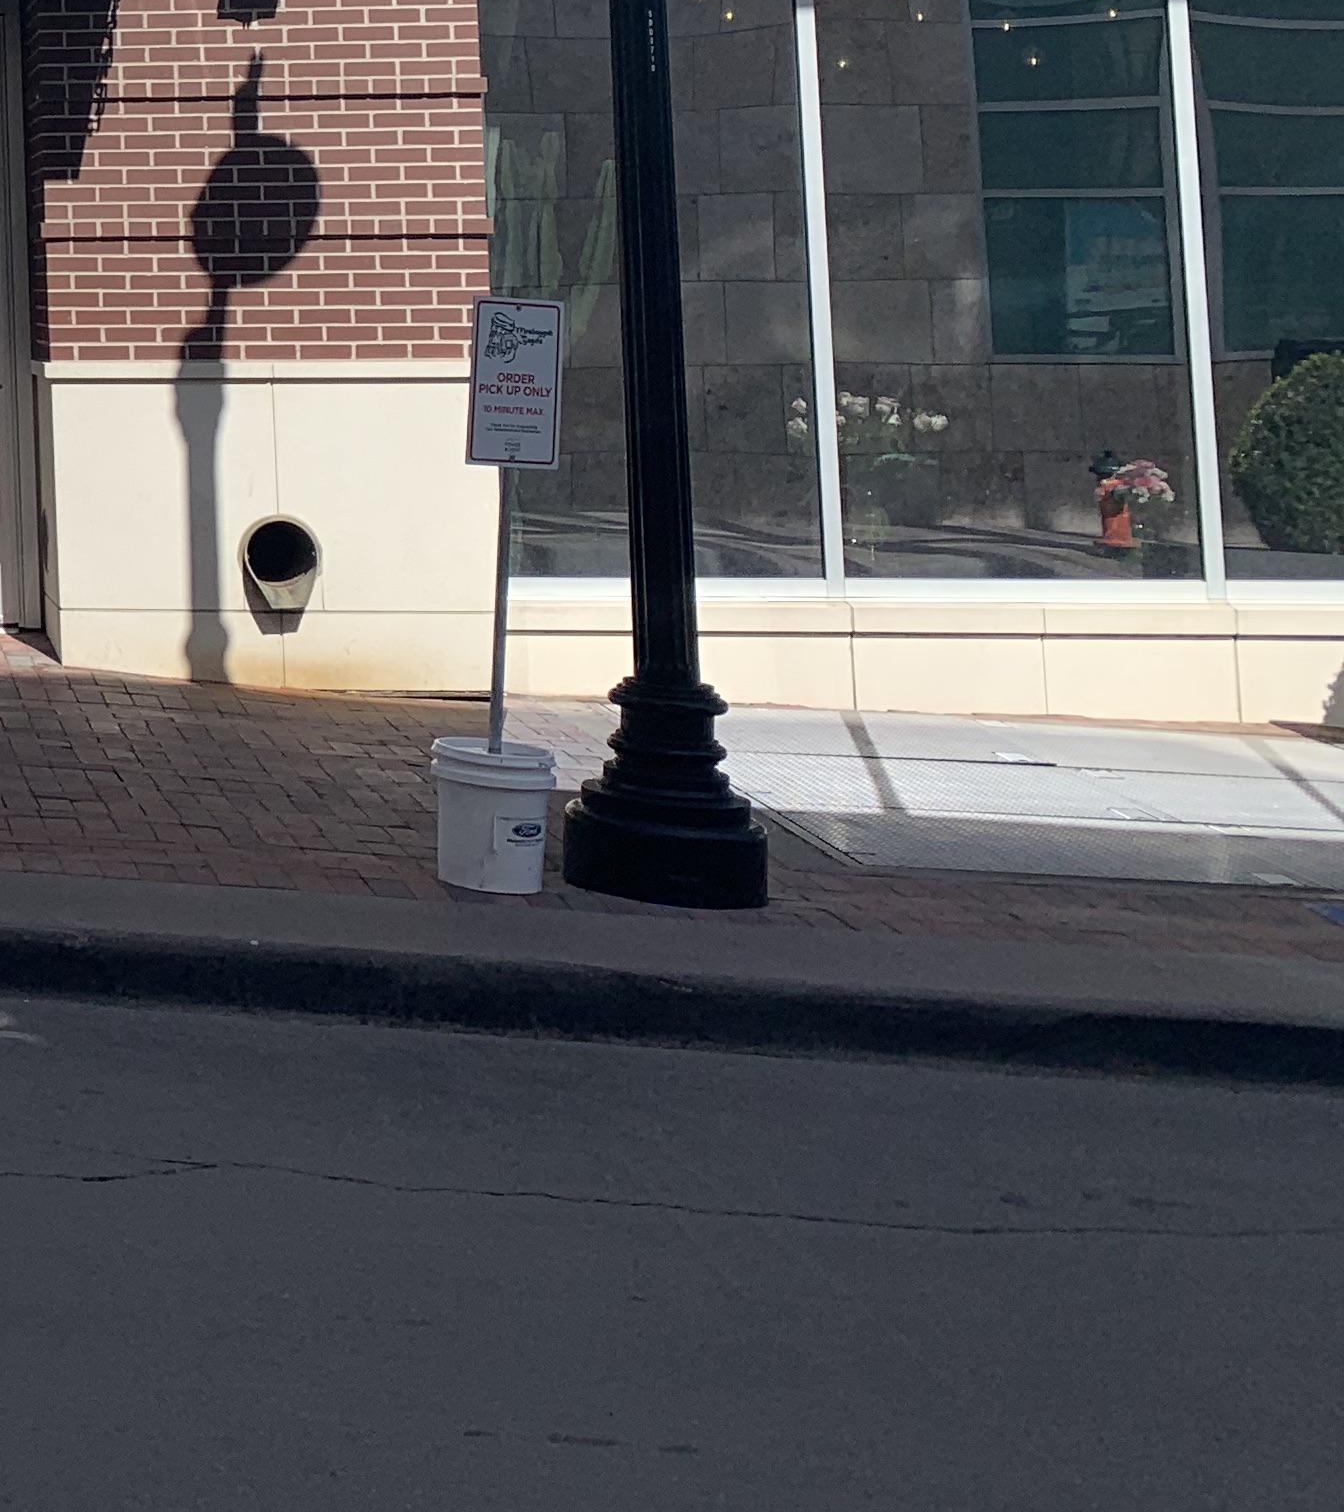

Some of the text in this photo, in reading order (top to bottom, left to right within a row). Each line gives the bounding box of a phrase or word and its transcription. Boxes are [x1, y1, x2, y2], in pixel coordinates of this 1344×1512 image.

[496, 372, 535, 385] ORDER
[478, 384, 553, 398] PICK UP ONLY
[483, 404, 491, 414] 10
[494, 405, 525, 415] MINUTE
